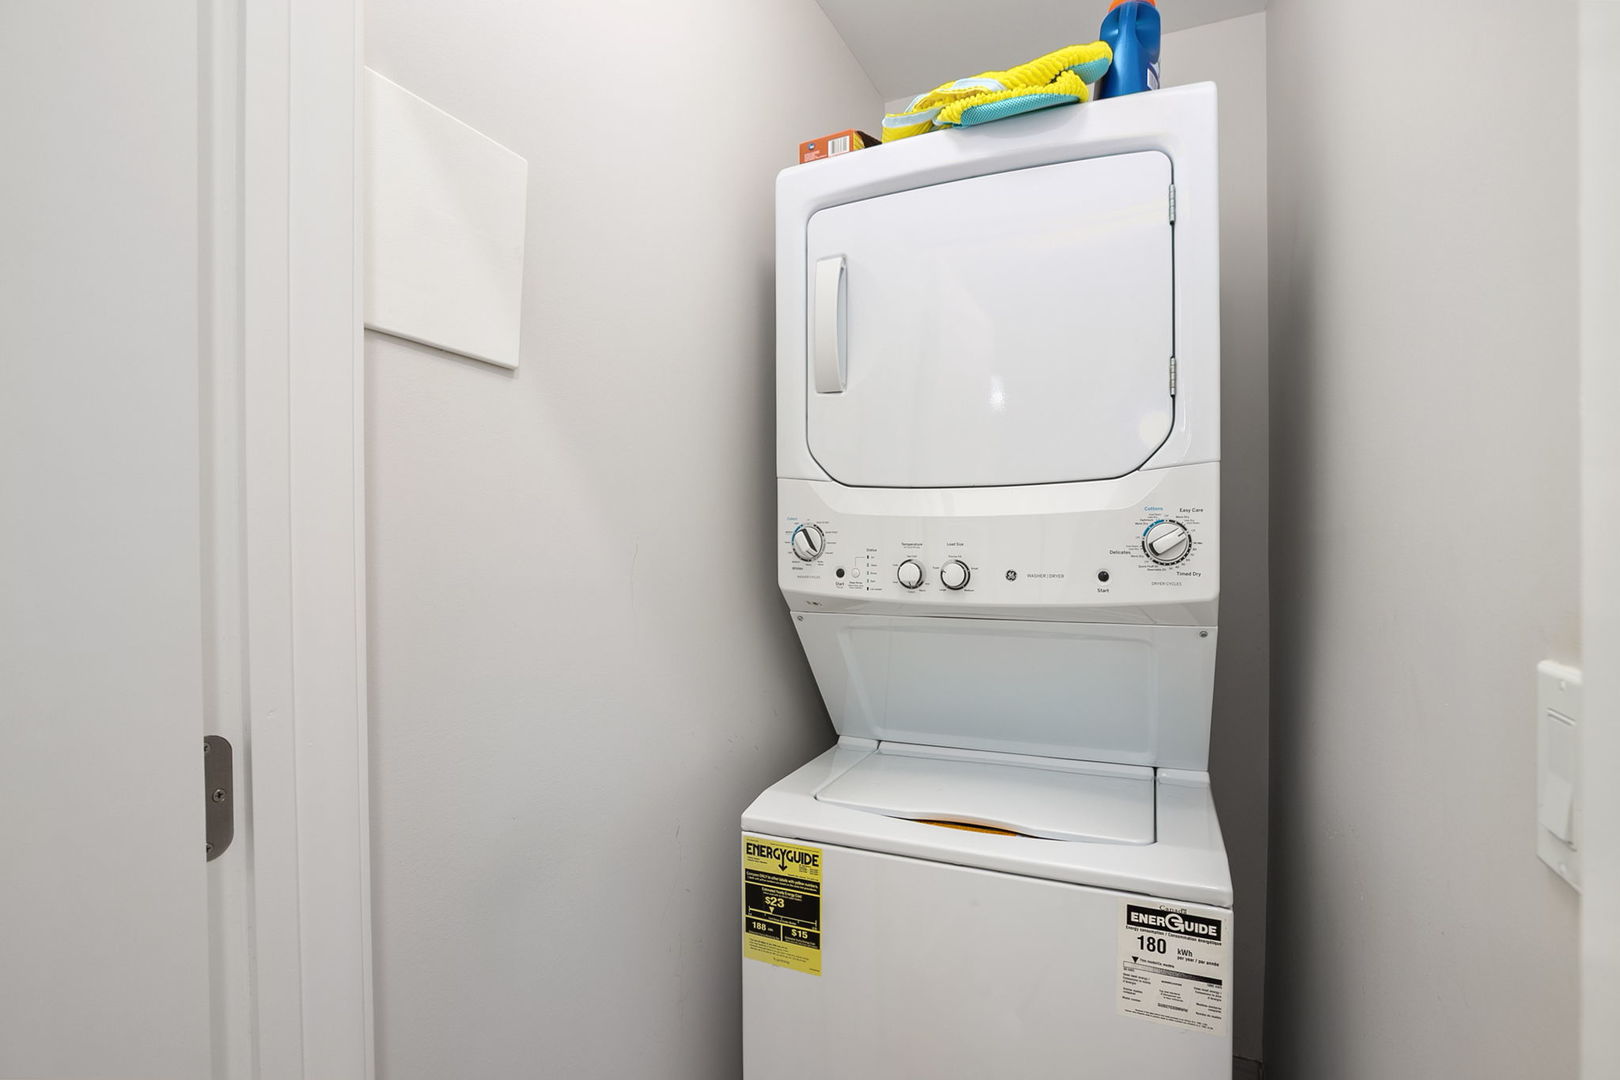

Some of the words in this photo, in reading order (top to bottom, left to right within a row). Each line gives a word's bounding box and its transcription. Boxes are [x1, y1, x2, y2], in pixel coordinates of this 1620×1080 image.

[746, 842, 819, 867] ENERGYGUIDE
[765, 896, 785, 908] $23
[752, 921, 767, 931] 188
[1130, 911, 1217, 936] ENERGUIDE
[791, 929, 808, 939] $15
[1137, 935, 1167, 954] 180
[1177, 948, 1193, 957] kWh
